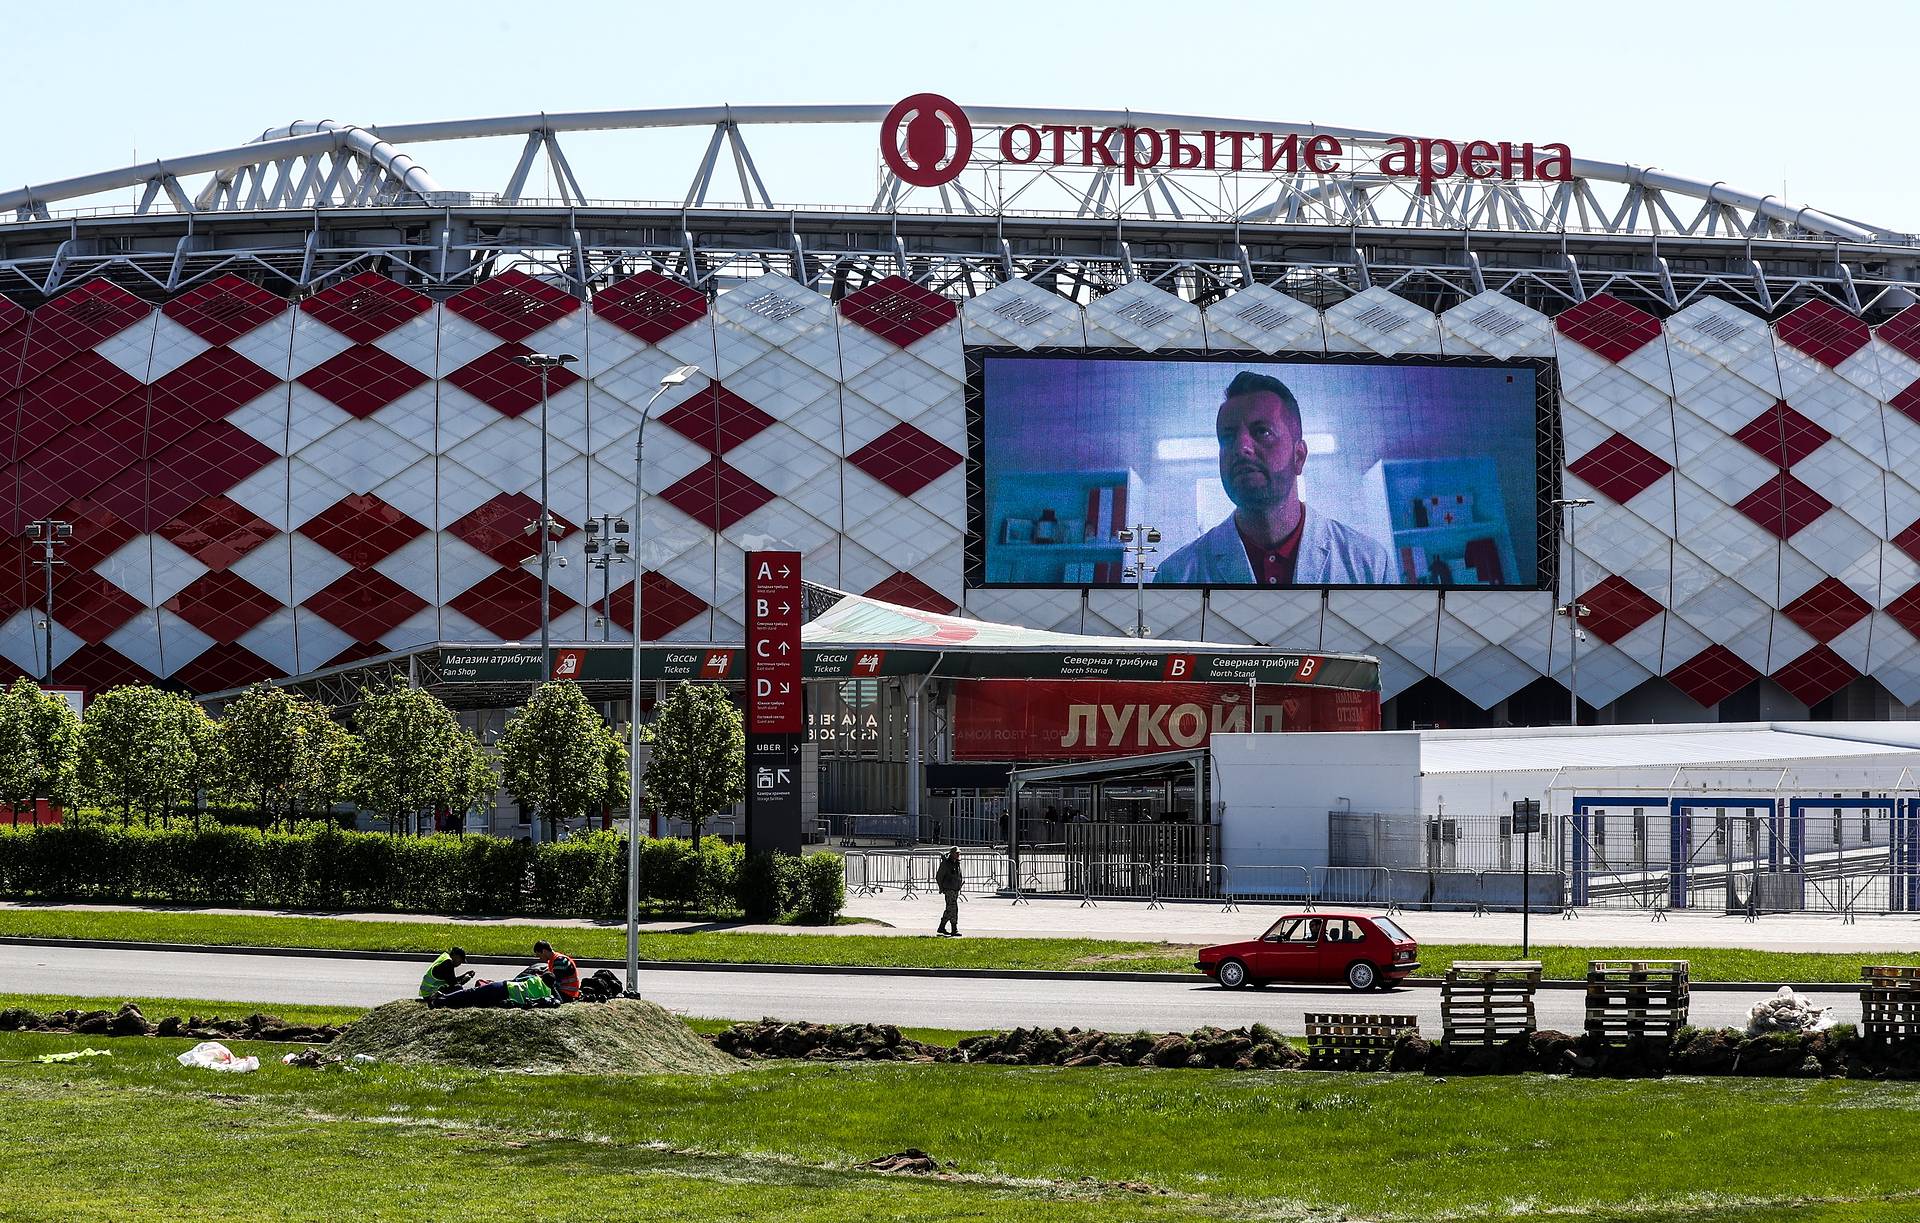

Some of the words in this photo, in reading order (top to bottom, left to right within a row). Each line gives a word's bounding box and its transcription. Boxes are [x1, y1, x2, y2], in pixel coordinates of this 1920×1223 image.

[1000, 124, 1343, 186] открытие
[1379, 137, 1574, 196] арена
[757, 562, 772, 580] A
[757, 599, 769, 617] B
[757, 639, 770, 657] C
[446, 654, 488, 665] Магазин
[490, 653, 543, 666] атрибутик
[665, 653, 698, 663] Кассы
[815, 653, 848, 663] Кассы
[1063, 656, 1113, 666] Северная
[1115, 657, 1158, 667] трибуна
[1212, 658, 1259, 669] Северная
[1261, 658, 1299, 669] трибуна
[664, 666, 690, 674] Tickets
[814, 665, 841, 673] Tickets
[1085, 667, 1109, 675] Stand
[1171, 659, 1186, 676] B
[1300, 658, 1315, 676] B
[443, 668, 457, 676] Fan
[458, 668, 477, 678] Shop
[1234, 670, 1256, 678] Stand
[757, 678, 772, 697] D
[757, 743, 781, 751] UBER
